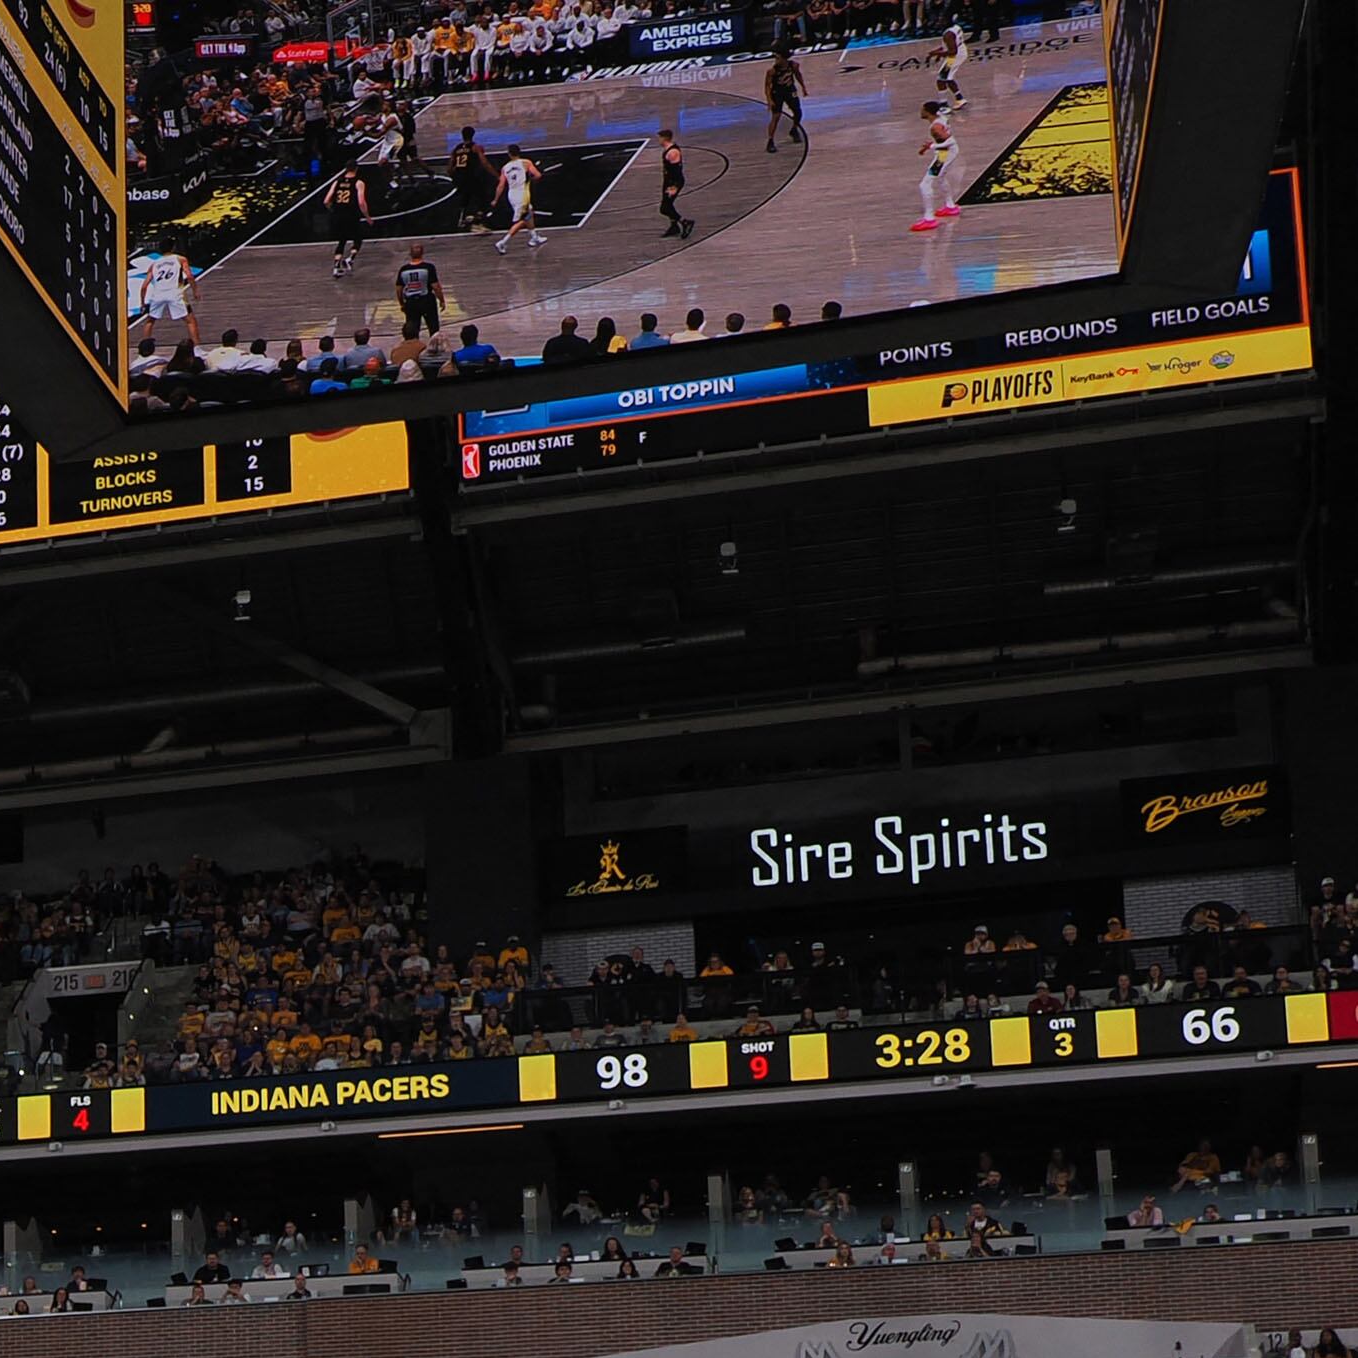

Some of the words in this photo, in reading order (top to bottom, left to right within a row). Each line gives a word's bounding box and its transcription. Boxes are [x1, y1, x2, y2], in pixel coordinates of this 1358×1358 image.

[639, 19, 732, 41] AMERICAN
[652, 31, 733, 51] EXPRESS
[157, 266, 174, 282] 26
[879, 341, 953, 366] POINTS
[1005, 318, 1118, 348] REBOUNDS
[1151, 306, 1200, 328] FIELD
[1204, 296, 1271, 322] GOALS
[617, 387, 654, 408] OBI
[657, 377, 735, 402] TOPPIN
[971, 369, 1054, 406] PLAYOFFS
[1070, 369, 1115, 384] KeyBank
[1164, 357, 1203, 375] Kroger
[1, 444, 24, 463] (7)
[489, 440, 536, 457] GOLDEN
[538, 434, 575, 450] STATE
[600, 429, 616, 442] 84
[638, 431, 647, 444] F
[247, 455, 258, 470] 2
[489, 453, 542, 472] PHOENIX
[600, 443, 616, 456] 79
[95, 469, 157, 491] BLOCKS
[243, 476, 264, 492] 15
[79, 489, 173, 514] TURNOVERS
[1141, 780, 1268, 833] Branson
[750, 828, 853, 887] Sire
[875, 813, 1049, 884] Spirits
[53, 975, 79, 991] 215
[1049, 1017, 1076, 1030] QTR
[1182, 1006, 1240, 1044] 66
[741, 1040, 774, 1054] SHOT
[874, 1029, 972, 1069] 3:28
[1054, 1031, 1074, 1057] 3
[595, 1053, 649, 1090] 98
[749, 1056, 769, 1080] 9
[70, 1095, 91, 1108] FLS
[211, 1081, 328, 1116] INDIANA
[336, 1073, 452, 1109] PACERS
[72, 1109, 89, 1132] 4
[845, 1320, 961, 1351] Yuengling
